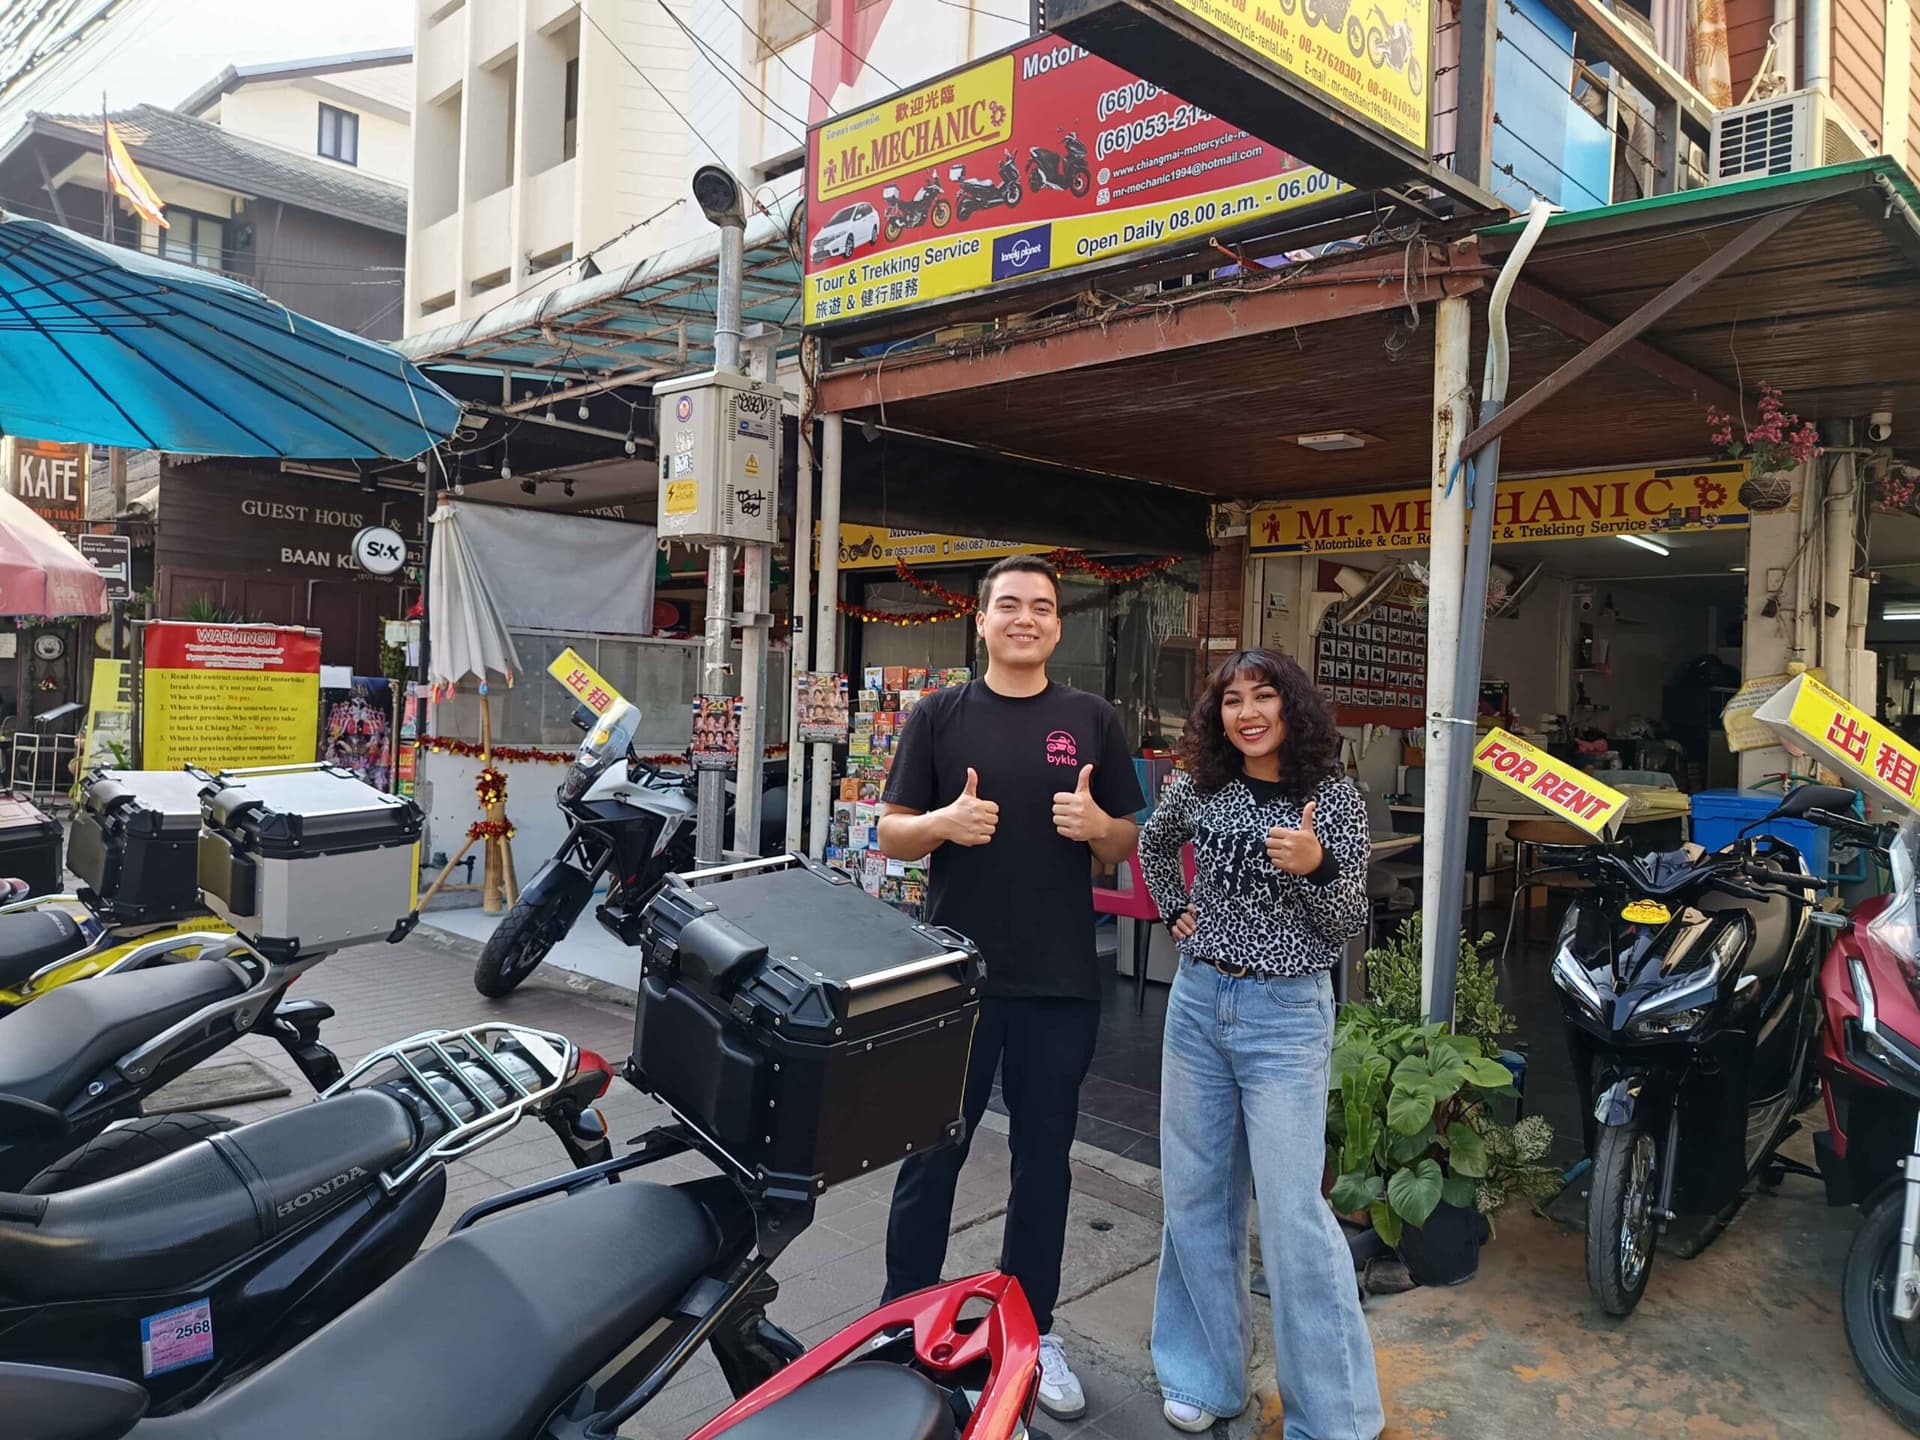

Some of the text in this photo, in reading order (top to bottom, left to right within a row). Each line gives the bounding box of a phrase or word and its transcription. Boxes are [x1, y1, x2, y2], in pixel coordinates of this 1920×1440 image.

[1255, 6, 1289, 39] Mobile
[1299, 35, 1364, 89] 08-27628302,
[1304, 61, 1327, 87] E-mail
[895, 85, 955, 124] 歡迎光臨
[840, 99, 986, 182] Mr.MECHANIC
[1112, 146, 1263, 198] mr-mechanic1994@hotmail.com
[1076, 234, 1118, 257] Open
[1123, 219, 1165, 243] Daily
[1169, 203, 1215, 231] 08.00
[1221, 195, 1260, 218] a.m.
[1277, 172, 1331, 202] 06.00
[815, 237, 980, 294] Tour & Trekking Service
[815, 278, 919, 319] 旅遊 & 健行服務
[241, 499, 308, 522] GUEST
[1296, 479, 1675, 540] Mr.MEHANIC
[894, 544, 936, 558] 053-214708
[1314, 537, 1372, 551] Motorbike
[1376, 535, 1387, 546] &
[1391, 534, 1412, 546] Car
[1503, 527, 1515, 538] &
[1519, 519, 1585, 538] Trekking
[1591, 519, 1647, 534] Service
[281, 548, 362, 570] BAAN KL
[566, 669, 611, 712] 出租
[1047, 753, 1077, 766] byklo
[1826, 711, 1918, 798] 出租
[1478, 740, 1612, 821] FOR RENT
[277, 1166, 368, 1217] HONDA
[176, 1320, 210, 1339] 2568
